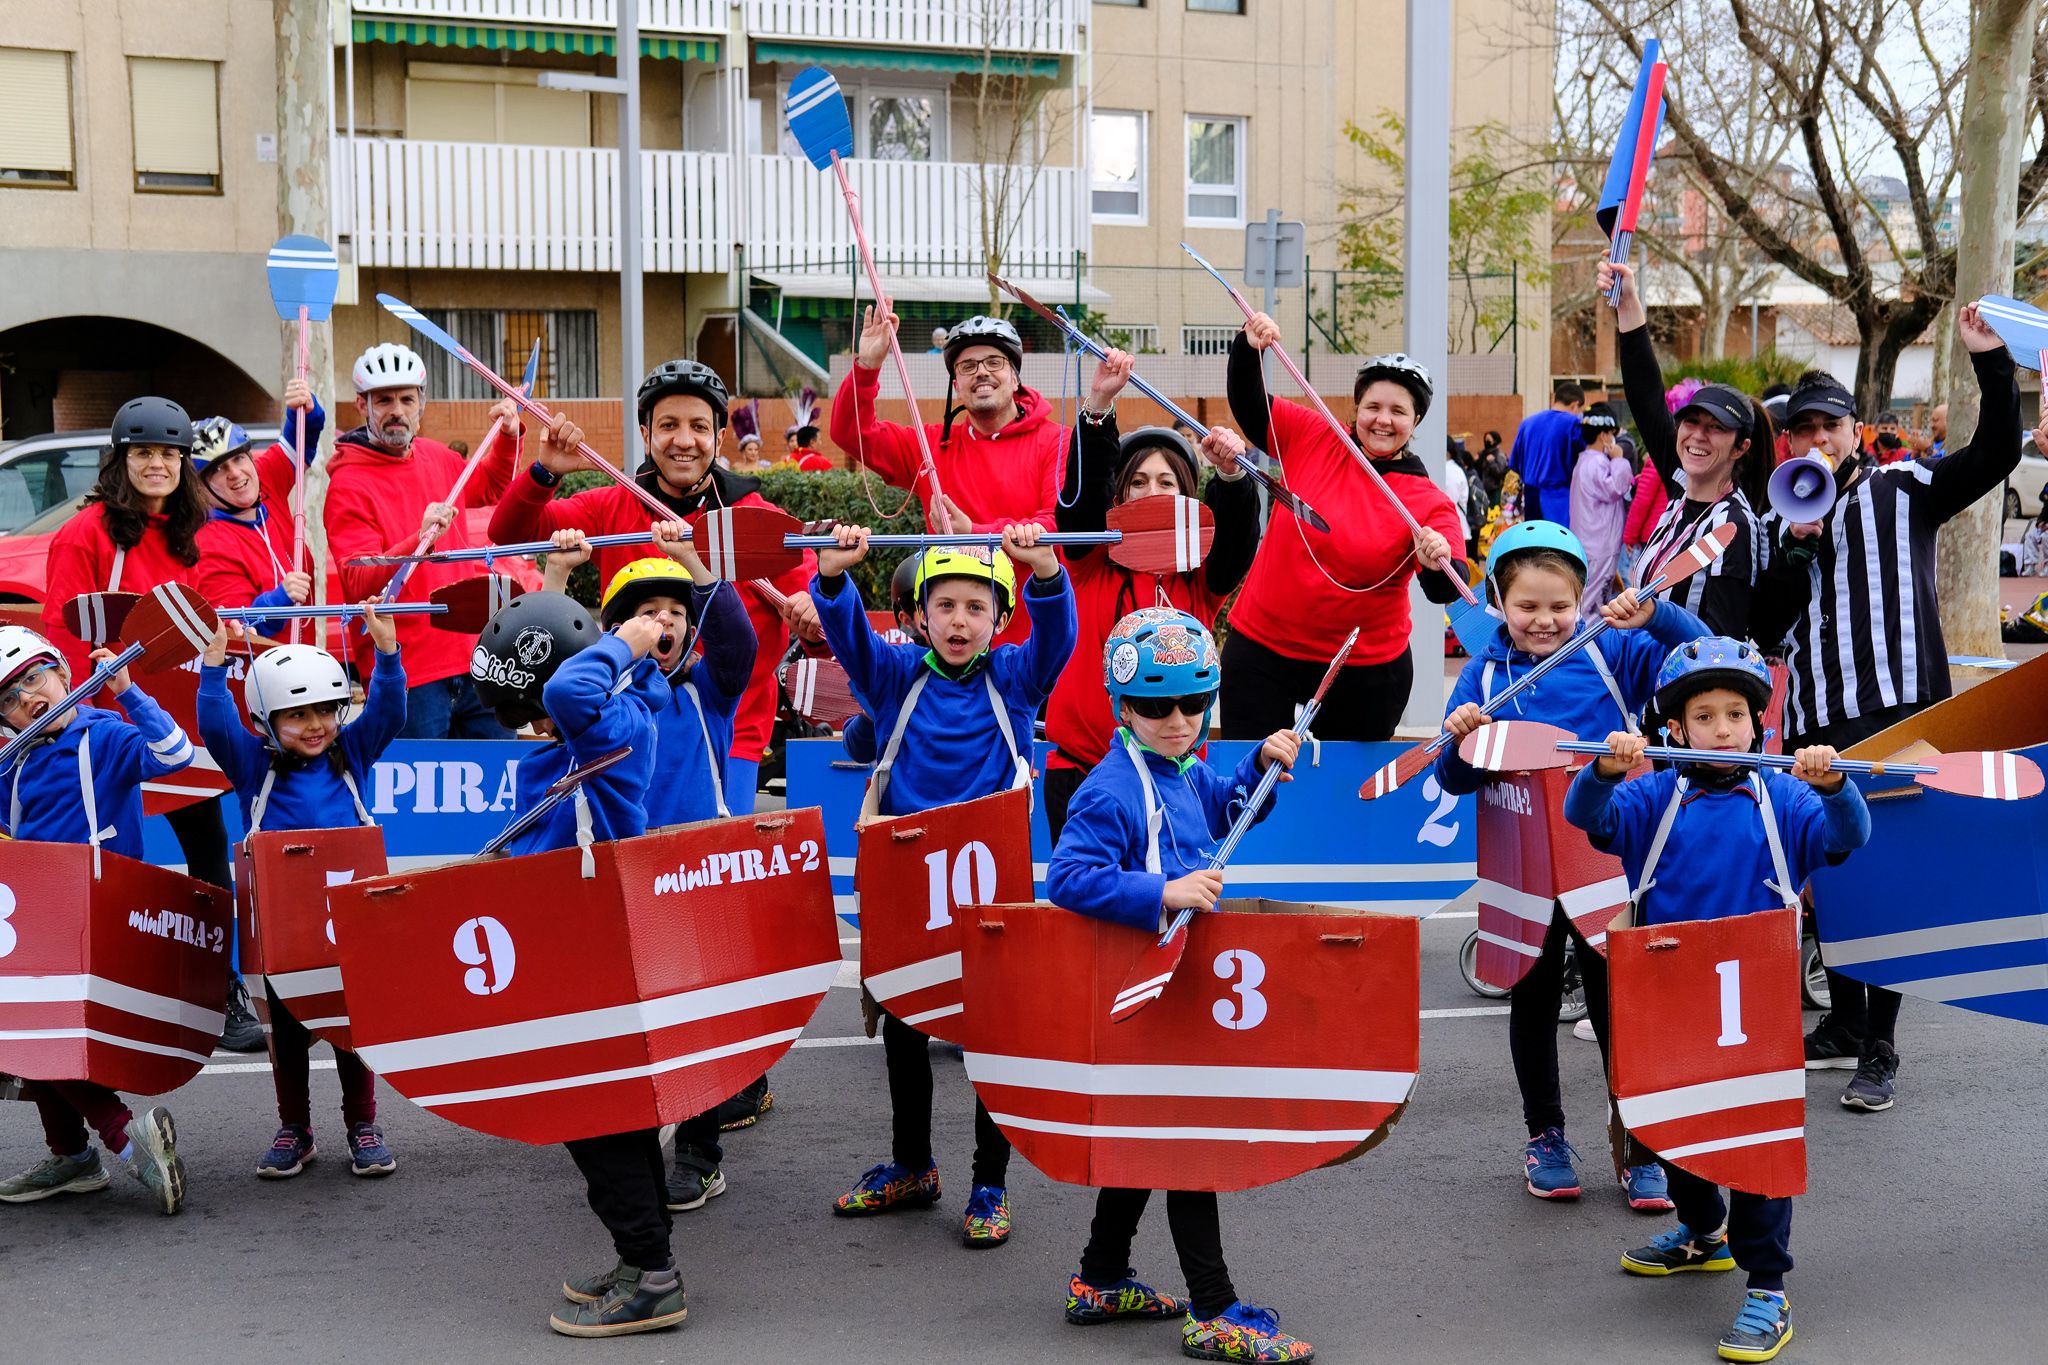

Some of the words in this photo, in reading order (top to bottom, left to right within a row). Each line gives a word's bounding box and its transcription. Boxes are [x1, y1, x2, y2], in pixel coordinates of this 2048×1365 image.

[470, 645, 536, 689] Slider
[1416, 773, 1460, 847] 2
[653, 840, 820, 896] miniPIRA-2
[924, 840, 997, 930] 10
[128, 909, 224, 953] miniPIRA-2
[452, 915, 516, 995] 9
[1212, 949, 1268, 1030] 3
[1715, 959, 1748, 1047] 1
